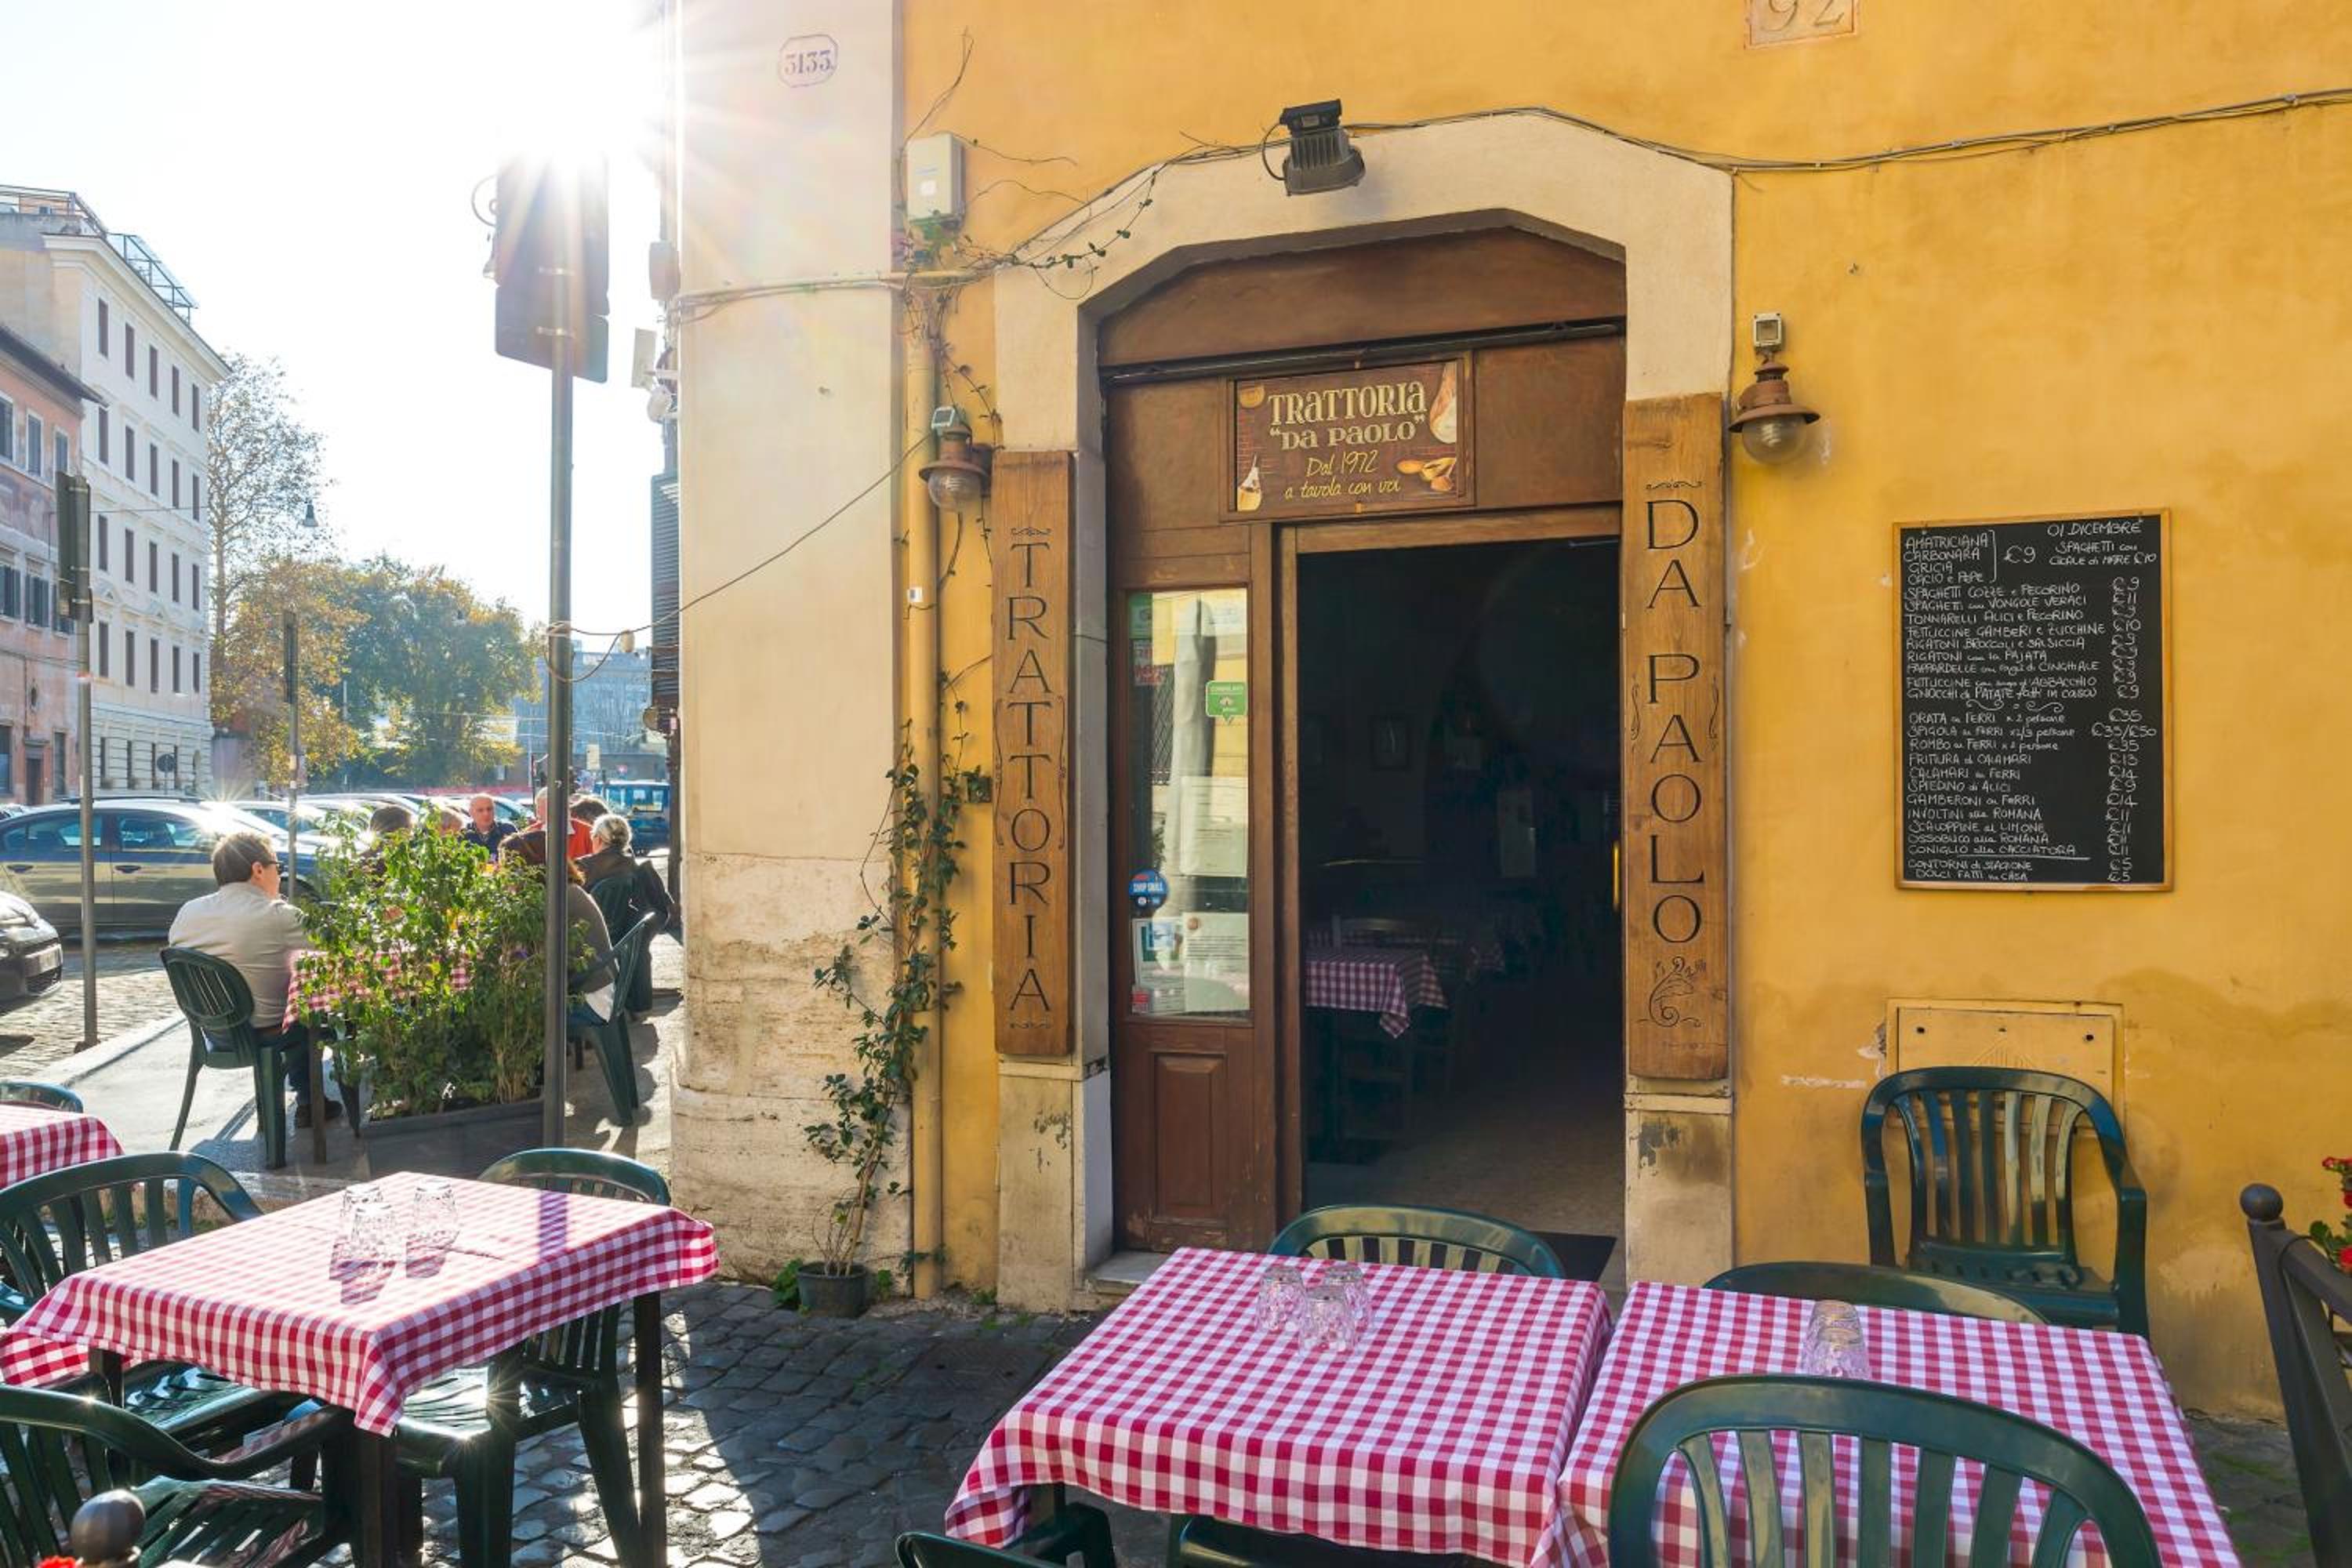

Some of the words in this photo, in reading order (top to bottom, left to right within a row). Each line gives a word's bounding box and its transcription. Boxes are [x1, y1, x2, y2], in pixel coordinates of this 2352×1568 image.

[1306, 453, 1335, 477] Dal
[1341, 449, 1378, 474] 1972
[1285, 487, 1294, 499] a
[1301, 477, 1341, 499] tavola
[1348, 482, 1372, 495] con
[1379, 479, 1402, 493] voi
[2068, 521, 2143, 537] DICEMBRE
[1646, 499, 1702, 609] DA
[2056, 540, 2114, 554] SPAGHETTI
[1904, 547, 1980, 562] CARBONARA
[2004, 545, 2036, 564] €9
[1908, 561, 1953, 574] GRICIA
[1907, 573, 1944, 586] CACIO
[1905, 586, 1961, 600] SPAGHETTI
[1905, 598, 1963, 612] SPAGHETTI
[1988, 597, 2038, 609] VONGOLE
[2044, 595, 2087, 607] VERACI
[1905, 613, 1977, 626] TONNARELLI
[1984, 610, 2014, 622] ALICI
[1906, 637, 1960, 651] RIGATONI
[2027, 636, 2085, 650] SALSICCIA
[1907, 650, 1962, 662] RIGATONI
[2005, 649, 2047, 664] PAJATA
[1907, 687, 1958, 699] GNOCCHI
[1908, 712, 1947, 724] ORATA
[2108, 708, 2143, 722] €35
[1907, 724, 1958, 738] SPIGOLA
[1909, 738, 1951, 751] ROMBO
[1977, 753, 2032, 765] CALAMARI
[1007, 542, 1052, 1012] TRATTORIA
[1910, 766, 1969, 781] CALAMARI
[1646, 652, 1705, 944] PAOLO
[1906, 793, 1982, 806] GAMBERONI
[1907, 808, 1964, 820] INVOLTINI
[1993, 807, 2043, 821] ROMANA
[1999, 822, 2045, 833] LIMONE
[1907, 833, 1970, 844] OSSOBUCO
[2000, 832, 2049, 844] ROMANA
[1907, 844, 1969, 855] CONIGLIO
[1998, 844, 2076, 855] CACCIATORA
[1907, 858, 1969, 869] CONTORNI
[1915, 868, 1951, 879] DOLCI
[2000, 872, 2028, 881] CASA
